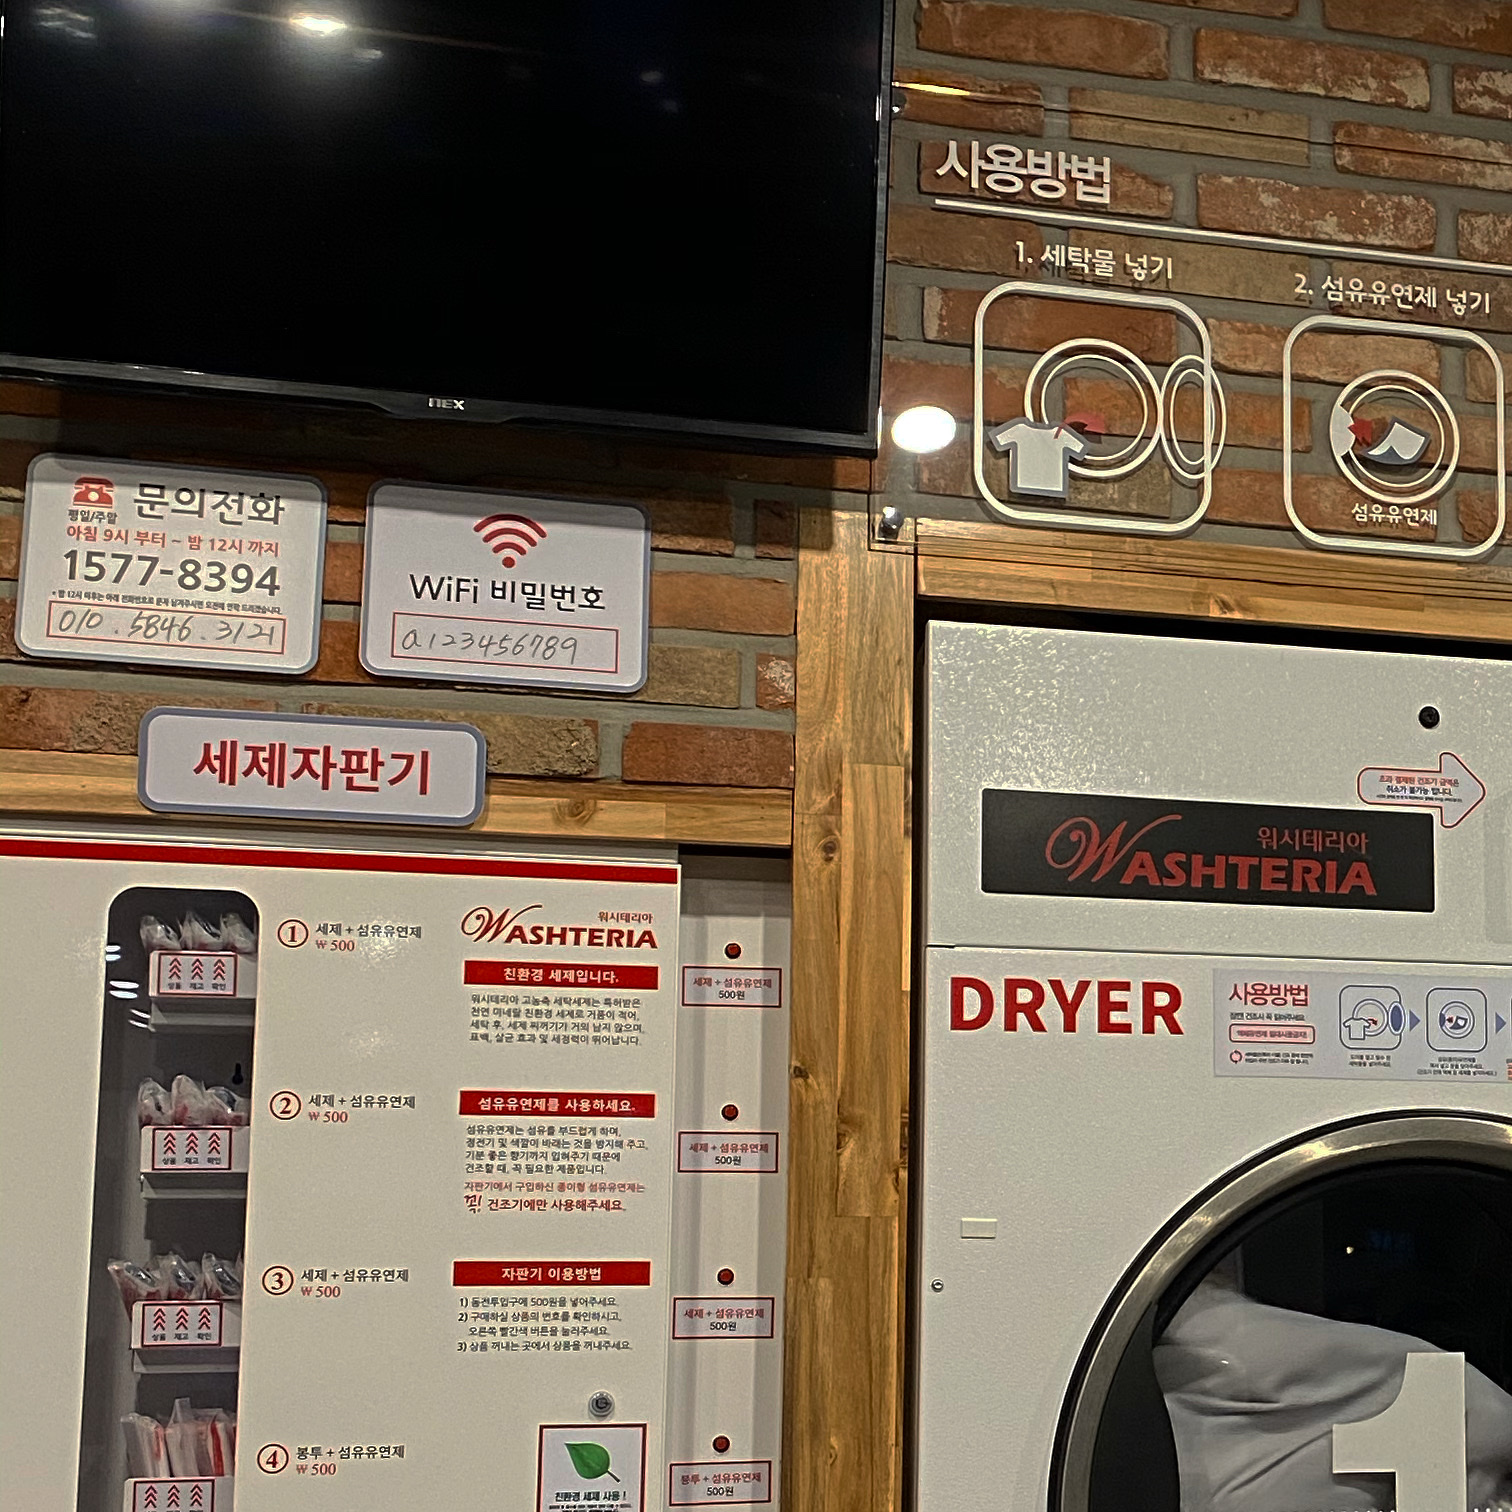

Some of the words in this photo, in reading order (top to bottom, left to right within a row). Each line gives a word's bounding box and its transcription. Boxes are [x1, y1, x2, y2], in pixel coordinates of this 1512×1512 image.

[936, 141, 1111, 204] 사용방법
[1016, 241, 1033, 264] 1.
[1040, 244, 1114, 278] 세탁물
[1125, 254, 1173, 280] 넣기
[1295, 273, 1313, 295] 2.
[1321, 274, 1437, 309] 섬유유연제
[1446, 286, 1491, 314] 넣기
[133, 483, 286, 526] 문의전화
[1351, 502, 1438, 527] 섬유유연제
[66, 525, 98, 543] 아침
[103, 528, 129, 545] 9시
[134, 530, 166, 548] 부터
[209, 537, 243, 555] 12시
[248, 541, 280, 558] 까지
[63, 549, 281, 597] 1577-8394
[410, 573, 479, 604] WiFi
[489, 579, 606, 611] 비밀번호
[193, 740, 430, 796] 세제자판기
[1256, 826, 1370, 855] 워시테리아
[1045, 813, 1378, 897] WASHTERIA
[460, 904, 659, 949] WASHTERIA
[597, 910, 654, 924] 워시테리아
[356, 923, 422, 940] 섬유유연제
[503, 967, 544, 982] 친환경
[548, 968, 620, 984] 세제입니다.
[718, 989, 745, 1001] 500원
[950, 976, 1185, 1036] DRYER
[1228, 982, 1310, 1008] 사용방법
[308, 1094, 335, 1108] 세제
[350, 1094, 416, 1110] 섬유유연제
[565, 1097, 636, 1112] 사용하세요.
[714, 1155, 742, 1166] 500원
[488, 1199, 548, 1212] 건조기에만
[300, 1268, 328, 1282] 세제
[342, 1268, 410, 1283] 섬유유연제
[501, 1267, 542, 1281] 자판기
[548, 1267, 602, 1282] 이용방법
[710, 1321, 737, 1332] 500원
[296, 1446, 323, 1460] 봉투
[338, 1445, 405, 1460] 섬유유연제
[706, 1485, 734, 1497] 500원
